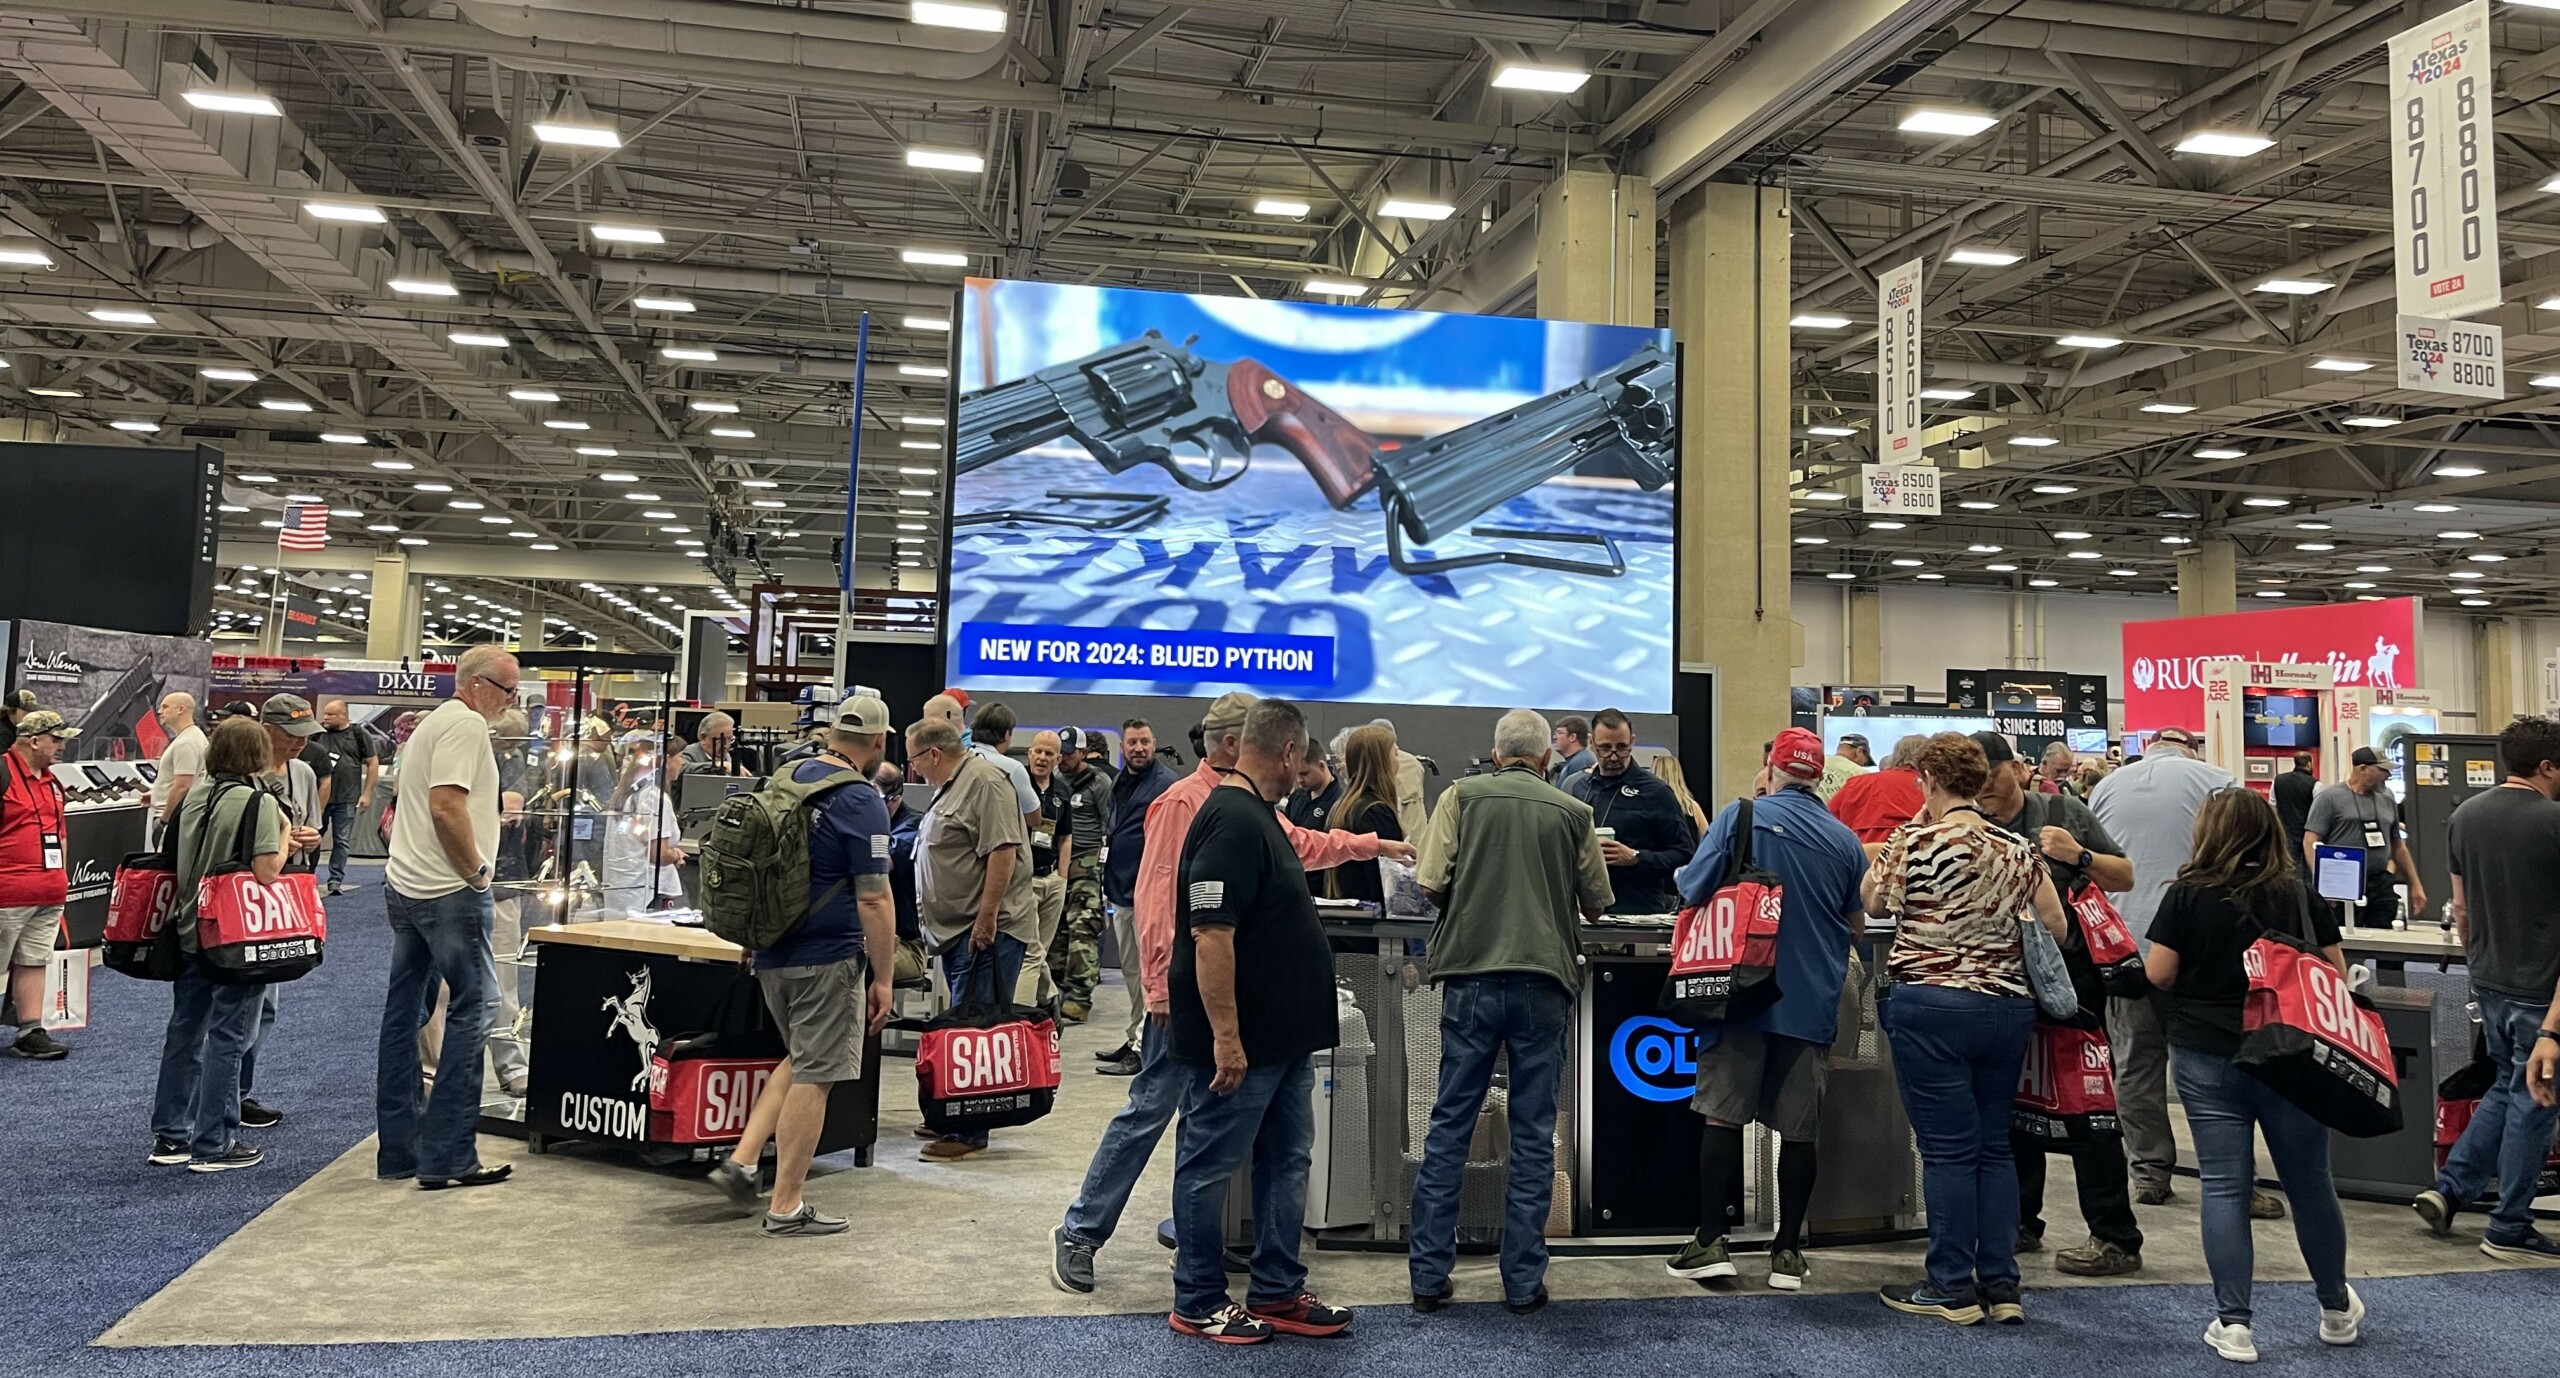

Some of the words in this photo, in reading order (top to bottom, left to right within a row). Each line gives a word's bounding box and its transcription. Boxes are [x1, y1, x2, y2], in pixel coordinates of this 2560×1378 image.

[2417, 40, 2468, 70] Texas
[2425, 57, 2461, 83] 2024
[2457, 76, 2481, 262] 8800
[2407, 97, 2429, 277] 8700
[1891, 284, 1912, 300] Texas
[2433, 282, 2450, 295] VOTE
[1894, 295, 1910, 309] 2024
[2406, 333, 2448, 352] Texas
[2453, 332, 2493, 357] 8700
[2411, 350, 2443, 364] 2024
[1907, 308, 1915, 428] 8600
[2453, 362, 2494, 387] 8800
[1869, 476, 1900, 488] Texas
[1902, 473, 1934, 488] 8500
[1873, 487, 1896, 495] 2024
[1903, 493, 1934, 508] 8600
[25, 639, 46, 669] Dan
[46, 650, 82, 673] Wesson
[980, 638, 1031, 661] NEW
[1037, 640, 1080, 663] FOR
[1086, 642, 1145, 665] 2024:
[1151, 644, 1219, 668] BLUED
[1225, 647, 1313, 671] PYTHON
[378, 673, 437, 690] DIXIE
[2156, 655, 2243, 690] RUG
[2275, 669, 2318, 680] Hornady
[2210, 681, 2228, 692] 22
[2207, 693, 2230, 702] ARC
[2396, 693, 2430, 701] Hornady
[2342, 703, 2358, 712] 22
[2003, 717, 2037, 735] SINCE
[2039, 719, 2065, 736] 1889
[1793, 750, 1813, 762] USA
[72, 859, 111, 886] Wesson
[1681, 897, 1735, 963] SAR
[952, 1032, 1014, 1088] SAR
[1609, 1015, 1700, 1102] COL
[964, 1097, 1014, 1105] sarusa.com
[560, 1091, 647, 1142] CUSTOM
